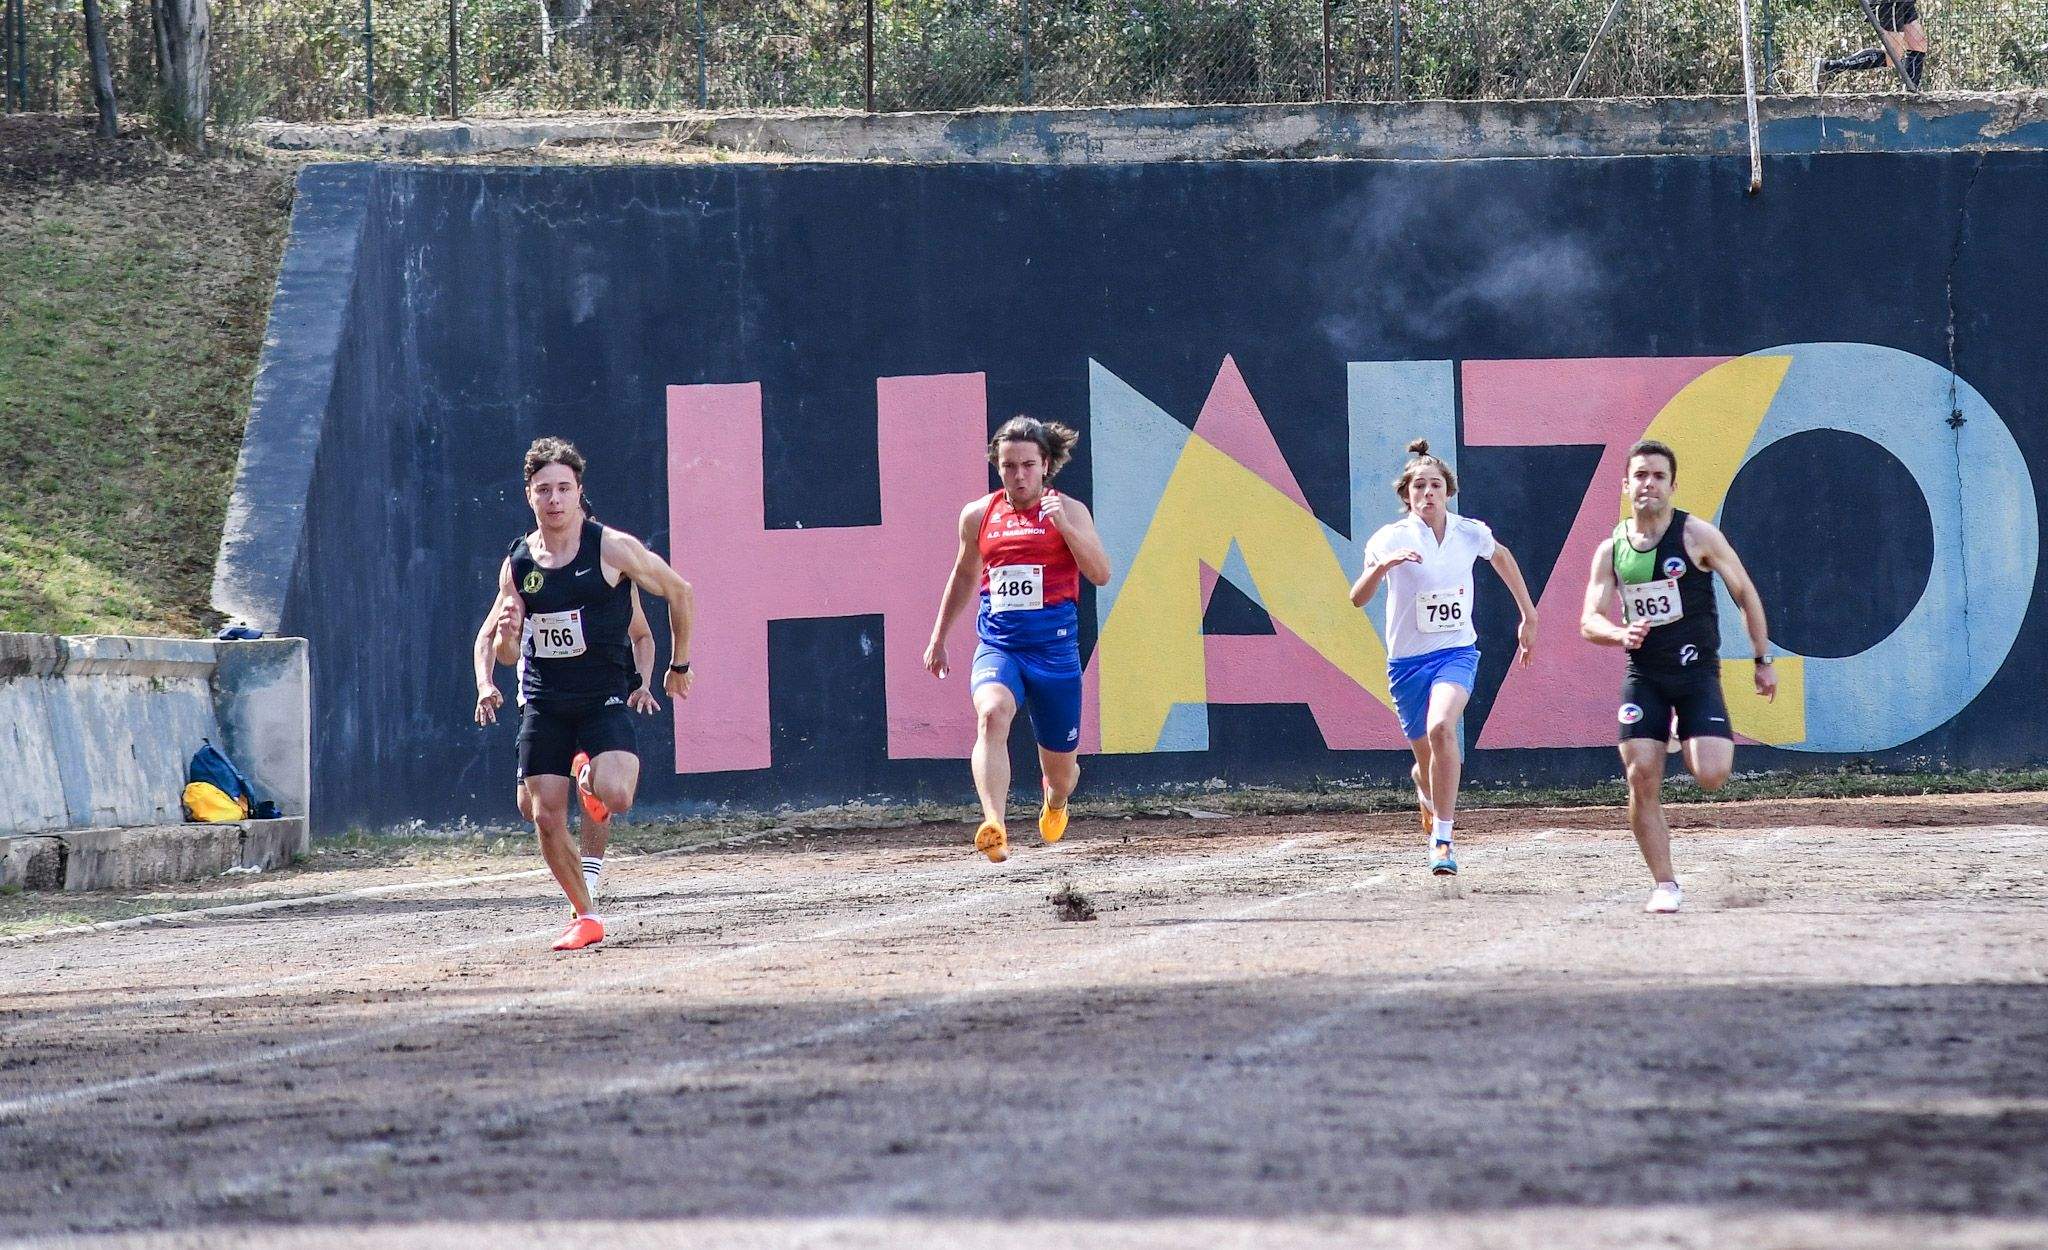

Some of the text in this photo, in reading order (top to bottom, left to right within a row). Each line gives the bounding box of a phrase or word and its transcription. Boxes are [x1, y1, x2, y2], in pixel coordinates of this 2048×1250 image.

[1002, 527, 1046, 537] MARATHON
[997, 580, 1033, 597] 486
[1426, 601, 1462, 622] 796
[1634, 595, 1671, 617] 863
[539, 628, 574, 648] 766
